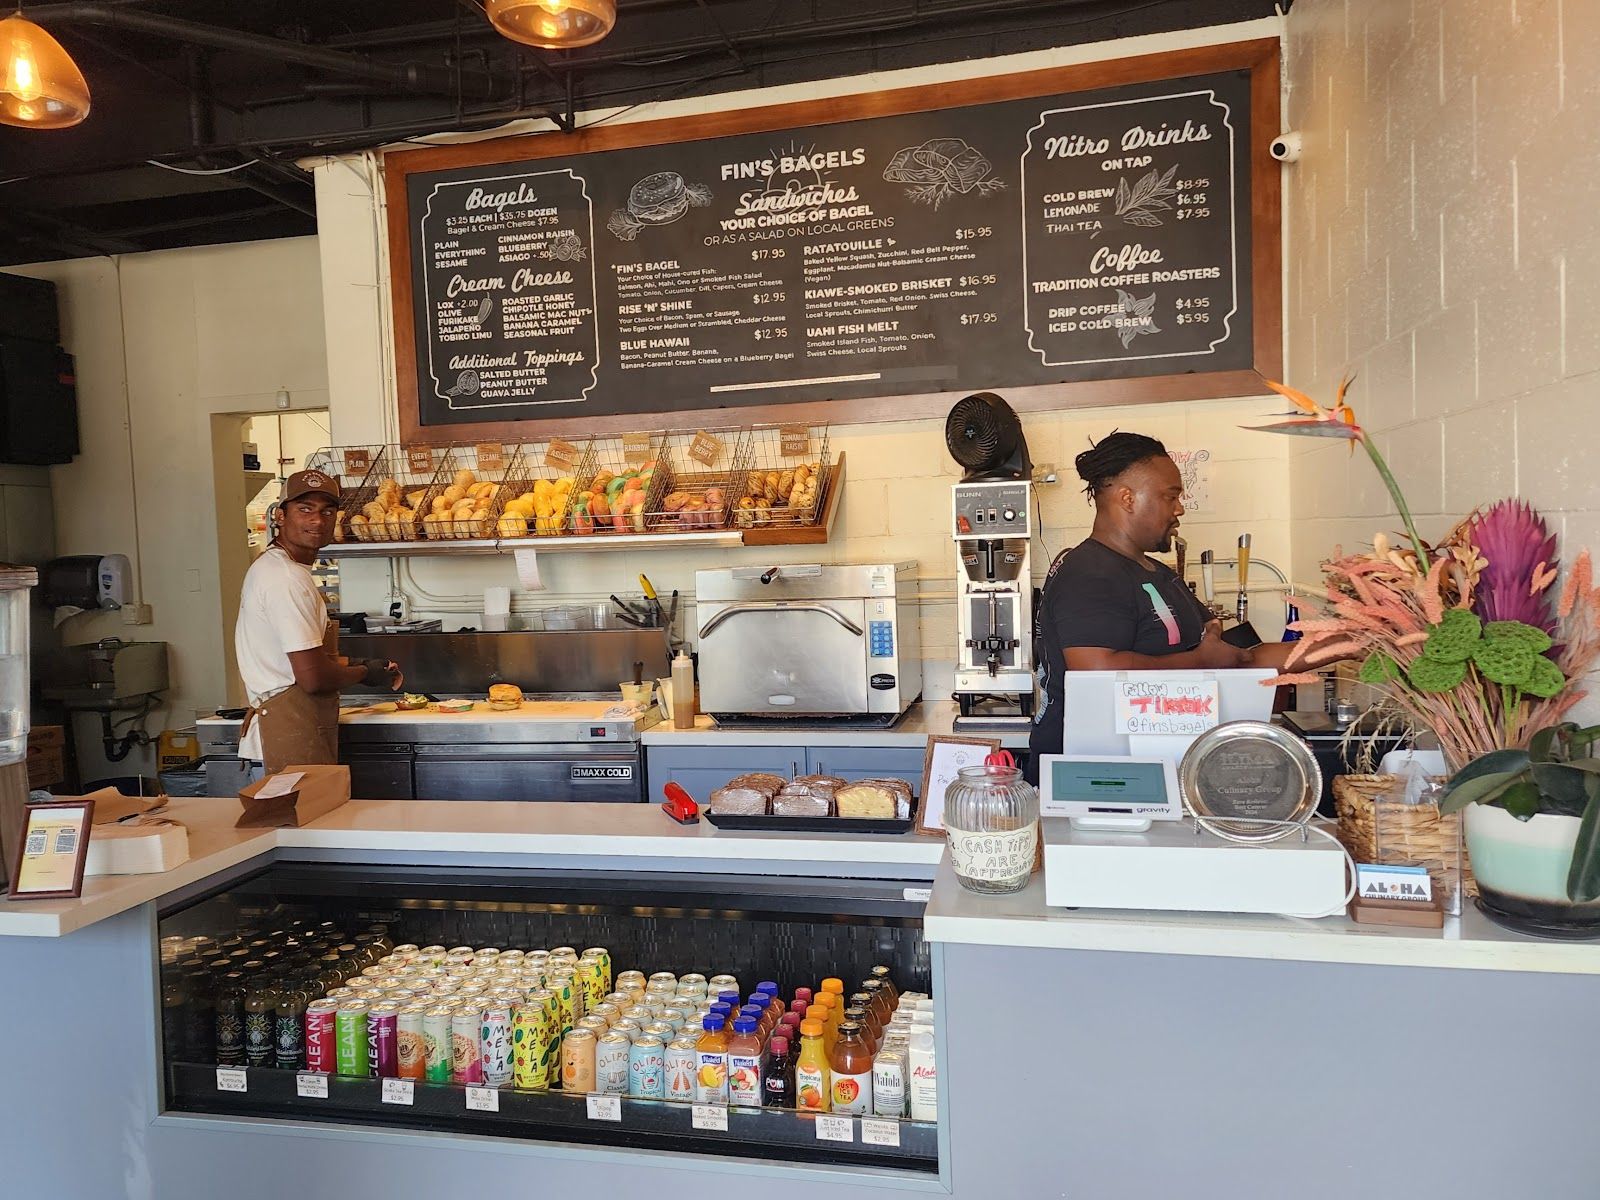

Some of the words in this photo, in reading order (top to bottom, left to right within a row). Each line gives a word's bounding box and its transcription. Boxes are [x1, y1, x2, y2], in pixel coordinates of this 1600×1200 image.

[1044, 135, 1110, 160] Nitro
[1121, 119, 1212, 152] Drinks
[721, 159, 774, 181] FIN'S
[780, 148, 866, 174] BAGELS
[1101, 159, 1122, 172] ON
[1124, 155, 1152, 168] TAP
[466, 183, 537, 212] Bagels
[735, 183, 860, 216] Sandwiches
[1043, 193, 1076, 204] COLD
[1077, 188, 1115, 200] BREW
[1043, 203, 1100, 219] LEMONADE
[1177, 193, 1206, 206] $6.95
[469, 214, 493, 224] EACH
[528, 207, 557, 217] DOZEN
[720, 217, 756, 231] YOUR
[757, 212, 806, 227] CHOICE
[808, 210, 827, 222] OF
[829, 205, 873, 220] BAGEL
[447, 225, 470, 235] Bagel
[478, 223, 505, 232] Cream
[507, 220, 536, 228] Cheese
[704, 236, 720, 247] OR
[722, 234, 738, 244] AS
[738, 233, 747, 243] A
[749, 229, 785, 242] SALAD
[787, 227, 805, 237] ON
[807, 222, 845, 235] LOCAL
[847, 216, 895, 231] GREENS
[1046, 223, 1074, 234] THAI
[1077, 220, 1103, 231] TEA
[498, 232, 544, 243] CINNAMON
[545, 229, 575, 238] RAISIN
[803, 238, 882, 256] RATATOUILLE
[955, 226, 992, 240] $15.95
[434, 240, 459, 250] PLAIN
[498, 242, 548, 253] BLUEBERRY
[435, 247, 486, 260] EVERYTHING
[499, 252, 530, 263] ASIAGO
[752, 248, 786, 261] $17.95
[1089, 243, 1164, 274] Coffee
[435, 258, 468, 269] SESAME
[645, 260, 680, 272] BAGEL
[447, 274, 505, 298] Cream
[511, 268, 573, 293] Cheese
[804, 281, 898, 300] KIAWE-SMOKED
[901, 277, 953, 292] BRISKET
[959, 274, 997, 288] $16.95
[1032, 277, 1099, 294] TRADITION
[1100, 273, 1149, 287] COFFEE
[1151, 267, 1220, 283] ROASTERS
[437, 301, 453, 310] LOX
[502, 295, 541, 306] ROASTED
[542, 293, 574, 302] GARLIC
[753, 292, 786, 305] $12.95
[438, 309, 462, 318] OLIVE
[502, 303, 544, 314] CHIPOTLE
[545, 301, 576, 310] HONEY
[618, 304, 642, 315] RISE
[660, 300, 693, 311] SHINE
[1048, 307, 1077, 319] DRIP
[1080, 303, 1126, 316] COFFEE
[1175, 297, 1210, 310] $4.95
[438, 316, 479, 326] FURIKAKE
[503, 312, 546, 323] BALSAMIC
[547, 310, 566, 319] MAC
[619, 325, 631, 333] Two
[632, 324, 648, 333] Eggs
[648, 322, 662, 331] Over
[663, 320, 689, 330] Medium
[734, 315, 761, 324] Cheddar
[762, 314, 786, 322] Cheese
[1048, 321, 1077, 333] ICED
[1079, 319, 1112, 330] COLD
[1114, 316, 1153, 328] BREW
[1176, 313, 1209, 325] $5.95
[503, 320, 539, 331] BANANA
[541, 318, 582, 328] CARAMEL
[806, 326, 835, 338] UAHI
[838, 323, 864, 335] FISH
[867, 321, 899, 333] MELT
[960, 312, 998, 325] $17.95
[439, 333, 470, 342] TOBIKO
[472, 331, 492, 340] LIMU
[504, 328, 548, 339] SEASONAL
[549, 327, 575, 336] FRUIT
[754, 327, 788, 341] $12.95
[620, 339, 647, 351] BLUE
[649, 337, 690, 349] HAWAII
[807, 349, 826, 358] Swiss
[857, 345, 876, 353] Local
[878, 344, 907, 353] Sprouts
[449, 352, 517, 370] Additional
[523, 348, 584, 367] Toppings
[675, 359, 697, 367] Cream
[698, 357, 722, 365] Cheese
[739, 353, 773, 363] Blueberry
[774, 352, 795, 361] Bagel
[480, 370, 511, 379] SALTED
[513, 368, 546, 377] BUTTER
[480, 379, 514, 389] PEANUT
[515, 378, 548, 387] BUTTER
[480, 389, 511, 399] GUAVA
[511, 388, 536, 397] JELLY
[624, 444, 650, 453] RAINBOW
[694, 444, 713, 460] BERRY
[348, 459, 365, 468] PLAIN
[479, 453, 500, 462] SESAME
[1177, 686, 1200, 695] our
[580, 768, 606, 777] MAXX
[607, 768, 630, 777] COLD
[1218, 786, 1253, 795] Culinary
[966, 839, 1003, 854] CASH
[986, 854, 1018, 867] ARE
[1365, 882, 1427, 896] ALOHA
[492, 1025, 505, 1071] MELA
[527, 1027, 539, 1073] MELA
[766, 1078, 784, 1090] POM
[837, 1081, 853, 1089] JUST
